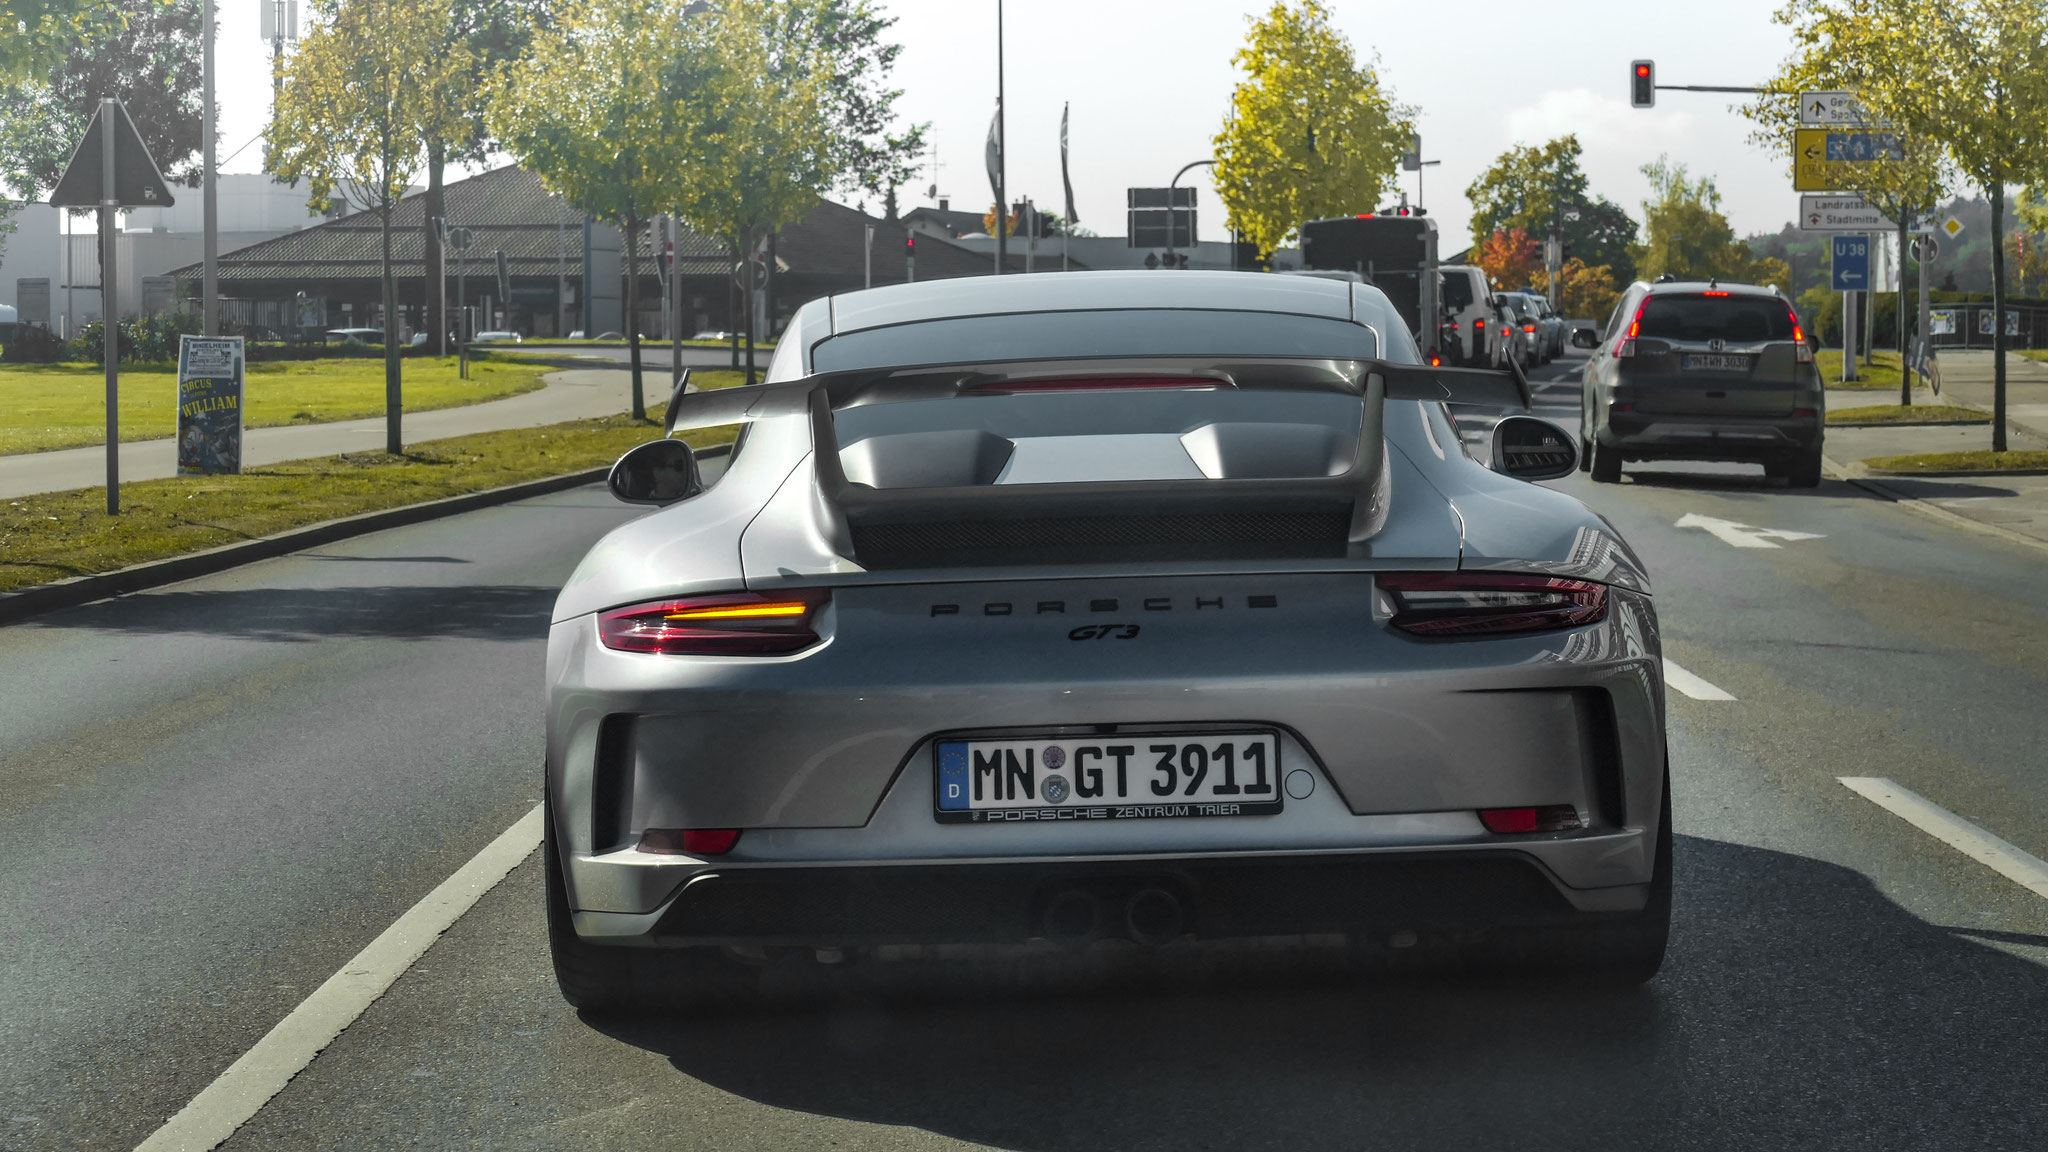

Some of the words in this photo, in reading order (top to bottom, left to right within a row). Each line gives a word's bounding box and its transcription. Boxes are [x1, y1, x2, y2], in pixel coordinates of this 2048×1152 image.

[1815, 200, 1877, 210] Landratsam
[1826, 214, 1879, 224] Stadtmitte
[1836, 243, 1846, 256] U
[1849, 243, 1866, 256] 38
[181, 378, 212, 393] CIRCUS
[181, 395, 238, 417] WILLIAM
[930, 594, 1278, 617] PORSCHE
[1068, 624, 1141, 641] GT3
[948, 783, 960, 798] D
[973, 748, 1035, 801] MN
[1074, 745, 1135, 798] GT
[1149, 742, 1272, 796] 3911
[987, 808, 1108, 821] PORSCHE
[1115, 806, 1189, 818] ZENTRUM
[1196, 804, 1241, 815] TRIER
